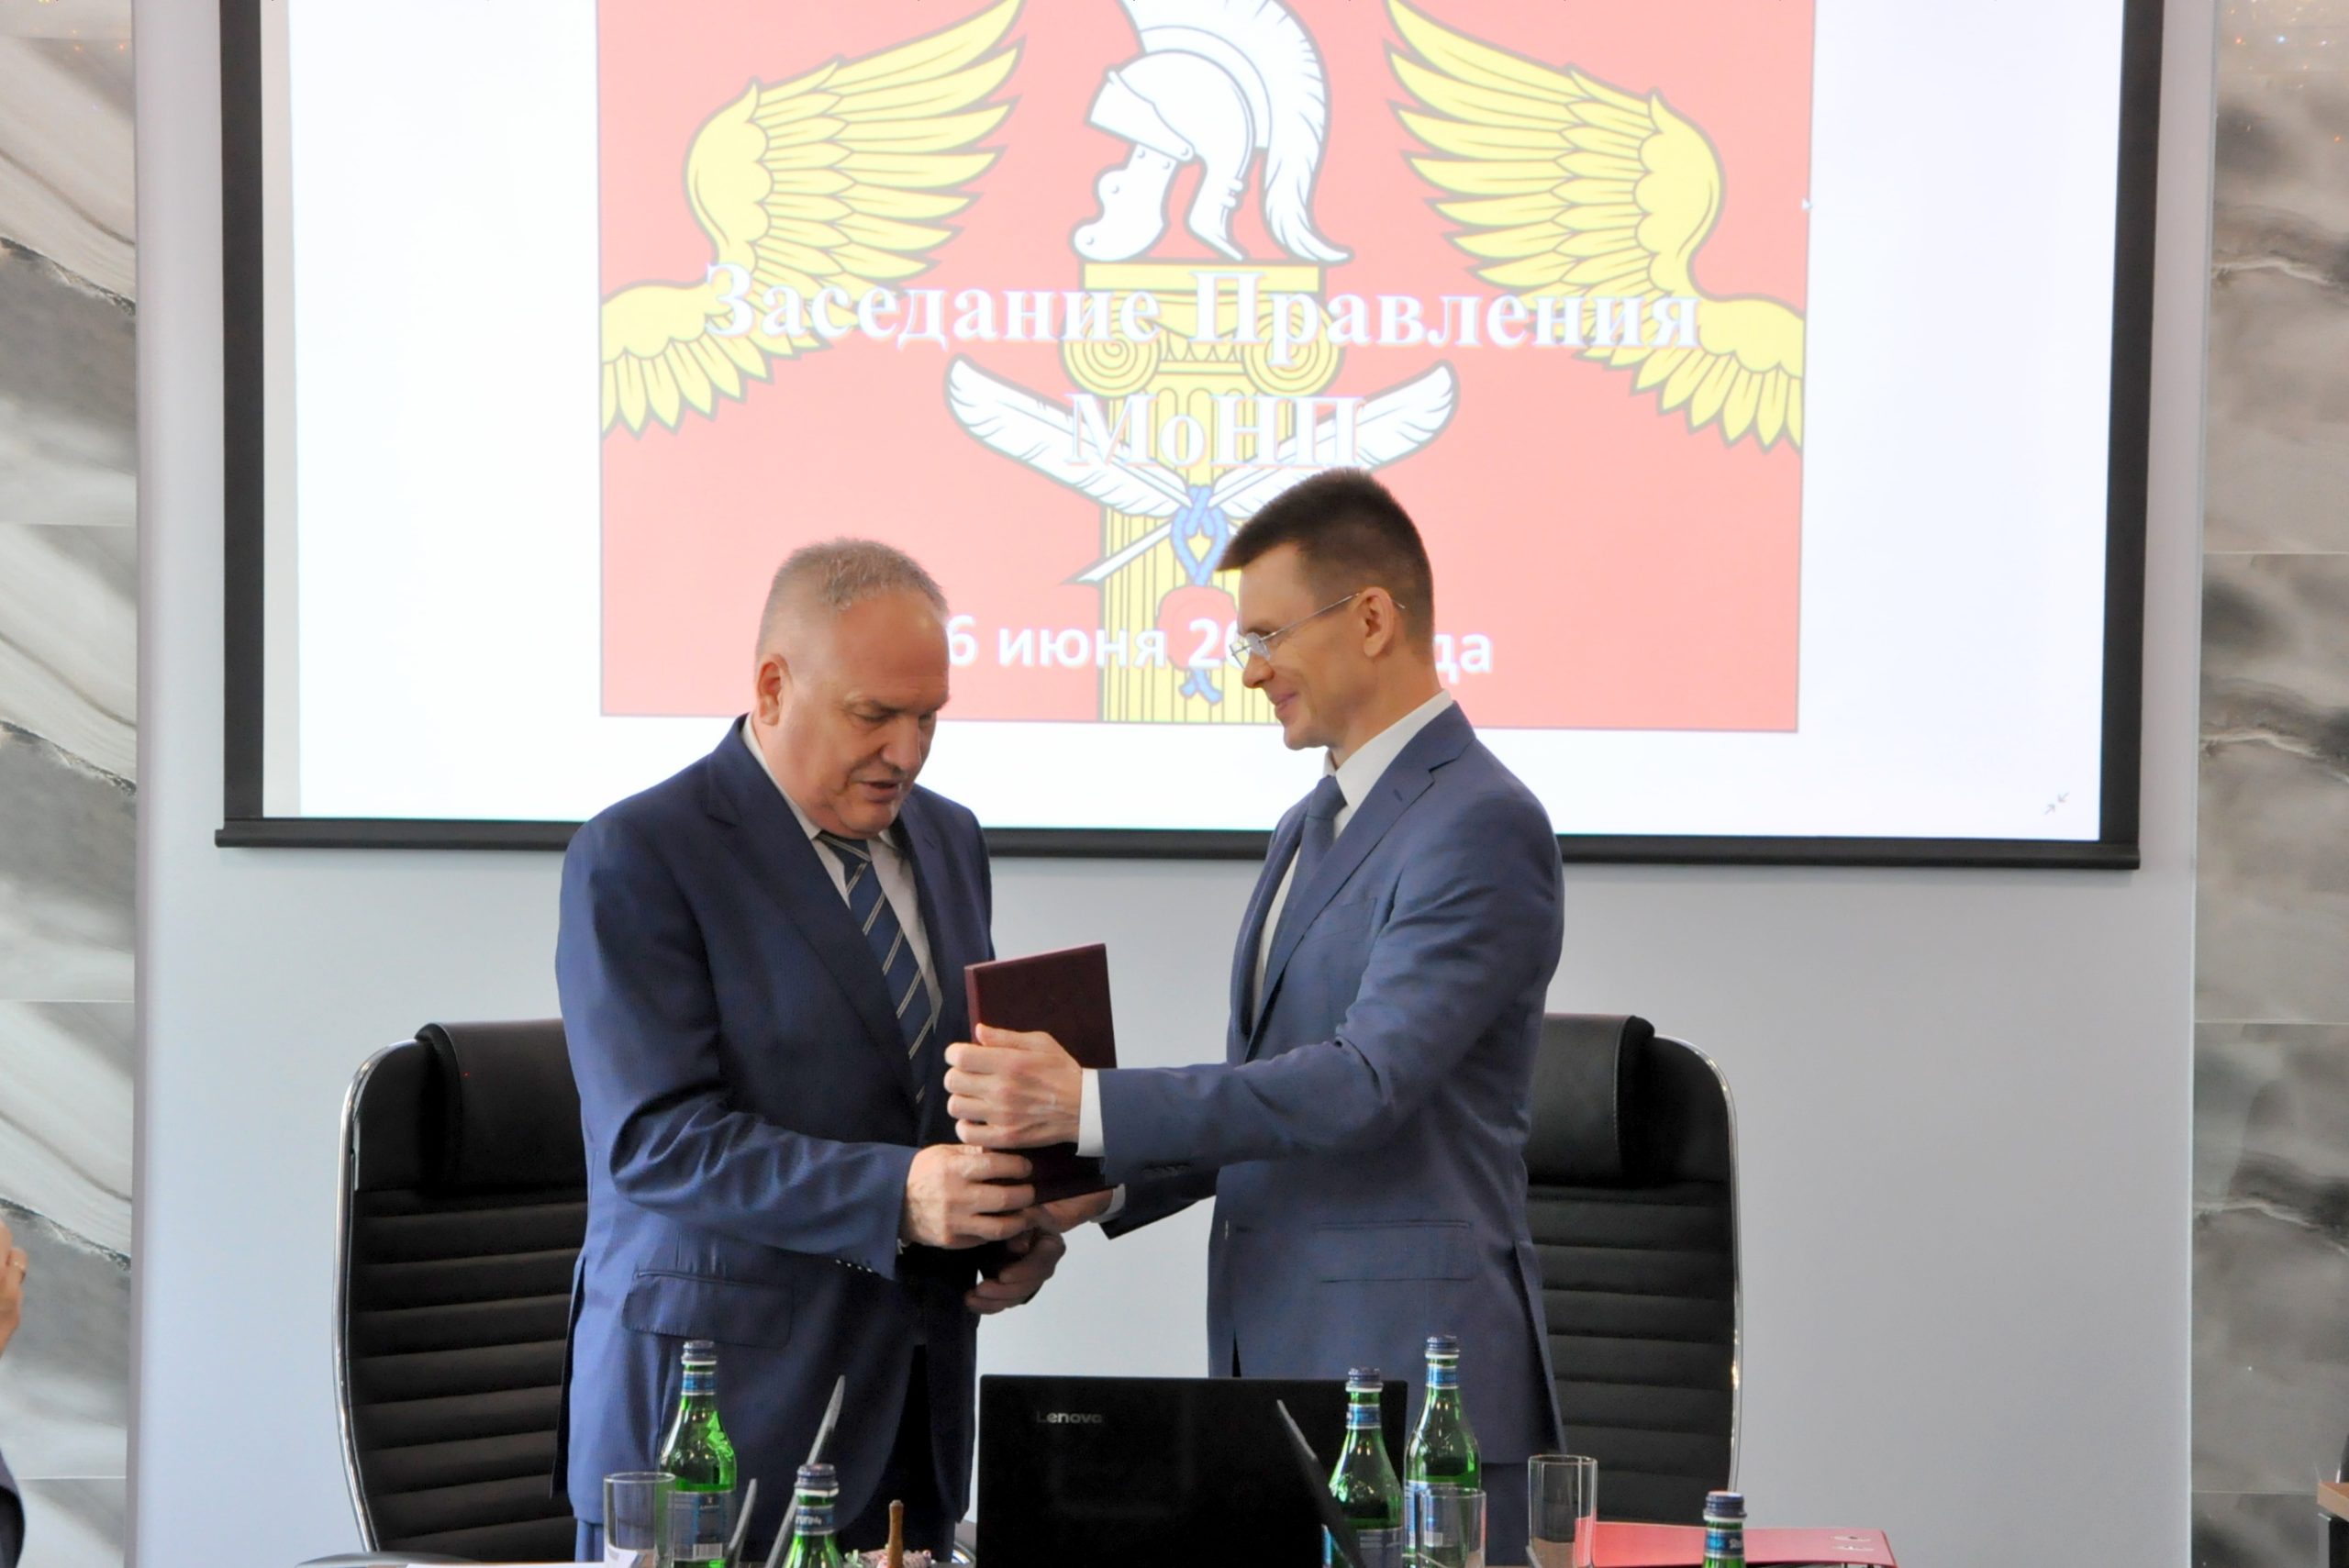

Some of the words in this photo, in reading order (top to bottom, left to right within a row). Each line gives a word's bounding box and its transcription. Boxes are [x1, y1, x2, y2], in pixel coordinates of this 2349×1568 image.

[705, 262, 1162, 350] Заседание
[1188, 269, 1700, 367] Правления
[1064, 391, 1365, 468] МоНП
[998, 628, 1167, 669] июня
[1036, 1411, 1104, 1424] Lenovo
